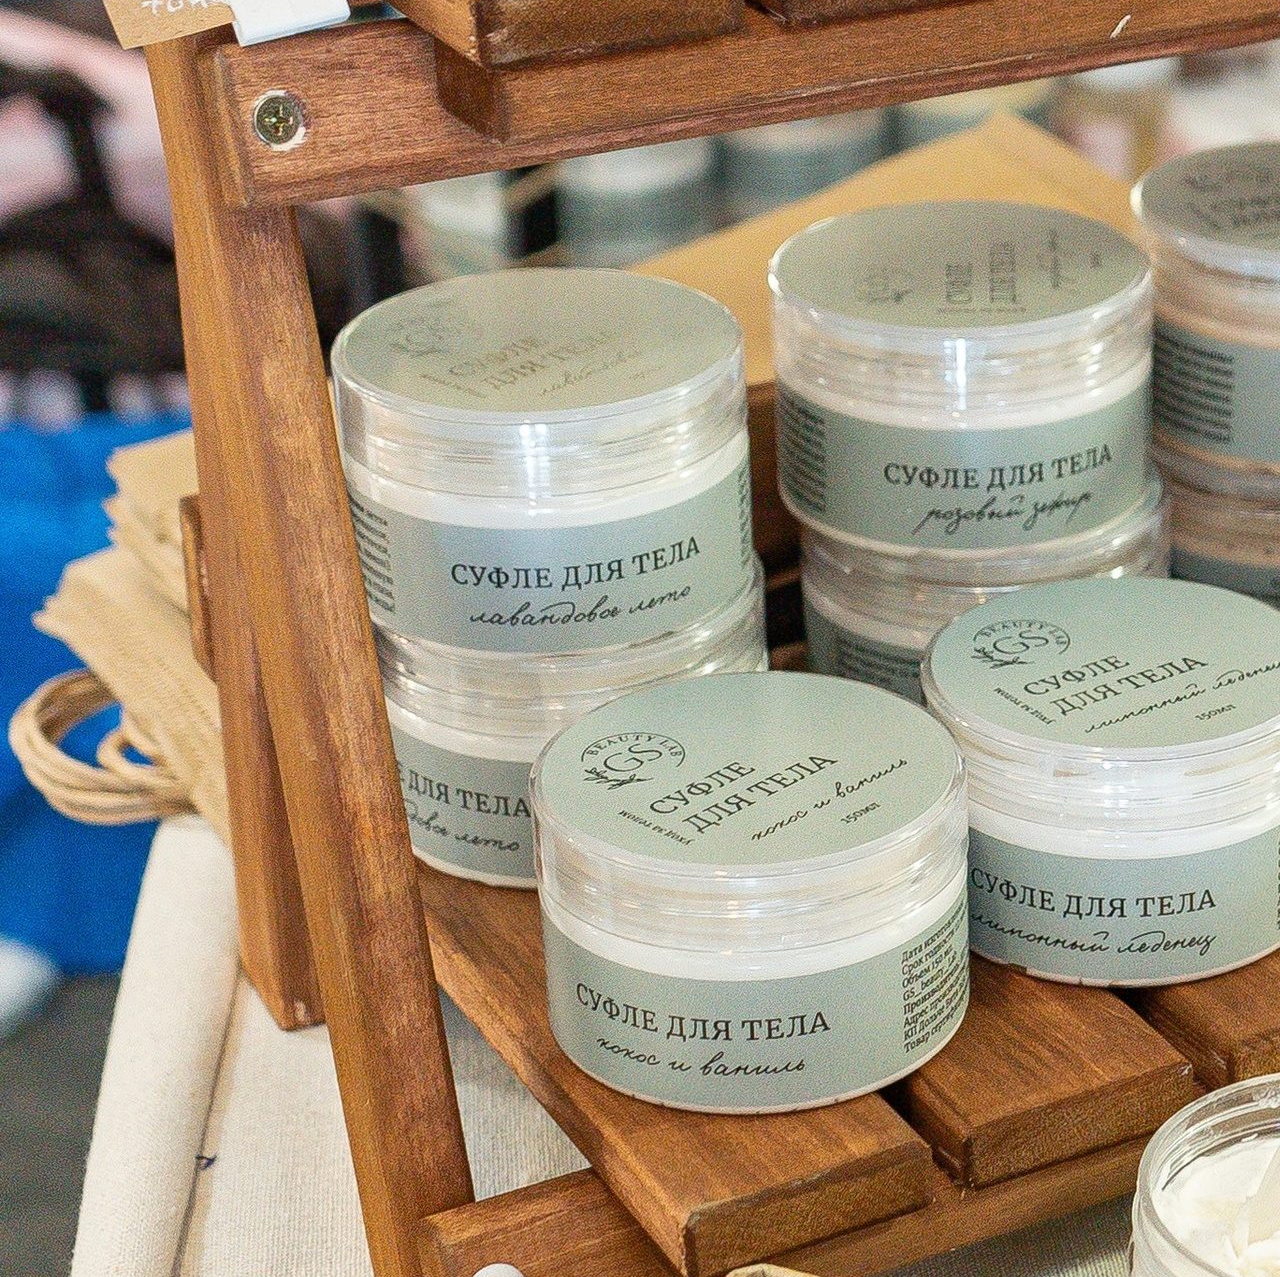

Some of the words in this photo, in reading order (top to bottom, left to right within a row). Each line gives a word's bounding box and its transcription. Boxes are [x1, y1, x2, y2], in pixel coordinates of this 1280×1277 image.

[883, 461, 980, 492] СУФЛЕ
[987, 462, 1045, 493] ДЛЯ
[1050, 442, 1114, 481] ТЕЛА
[450, 563, 553, 591] СУФЛЕ
[561, 559, 623, 592] ДЛЯ
[632, 535, 700, 575] ТЕЛА
[469, 593, 622, 626] лавандовое
[629, 584, 692, 617] лето
[992, 629, 1049, 654] GS
[1023, 655, 1131, 697] СУФЛЕ
[1049, 683, 1122, 717] ДЛЯ
[1117, 655, 1209, 690] ТЕЛА
[587, 733, 656, 757] BEAUTY
[603, 742, 663, 772] GS
[407, 768, 452, 805] ДЛЯ
[455, 787, 532, 818] ТЕЛА
[649, 761, 756, 816] СУФЛЕ
[682, 793, 755, 834] ДЛЯ
[746, 753, 839, 797] ТЕЛА
[971, 868, 1055, 912] СУФЛЕ
[1062, 894, 1127, 920] ДЛЯ
[1135, 888, 1217, 918] ТЕЛА
[576, 982, 659, 1033] СУФЛЕ
[666, 1014, 733, 1041] ДЛЯ
[740, 1010, 831, 1042] ТЕЛА
[597, 1033, 661, 1066] кокос
[667, 1059, 692, 1072] и
[699, 1050, 806, 1078] ваниль
